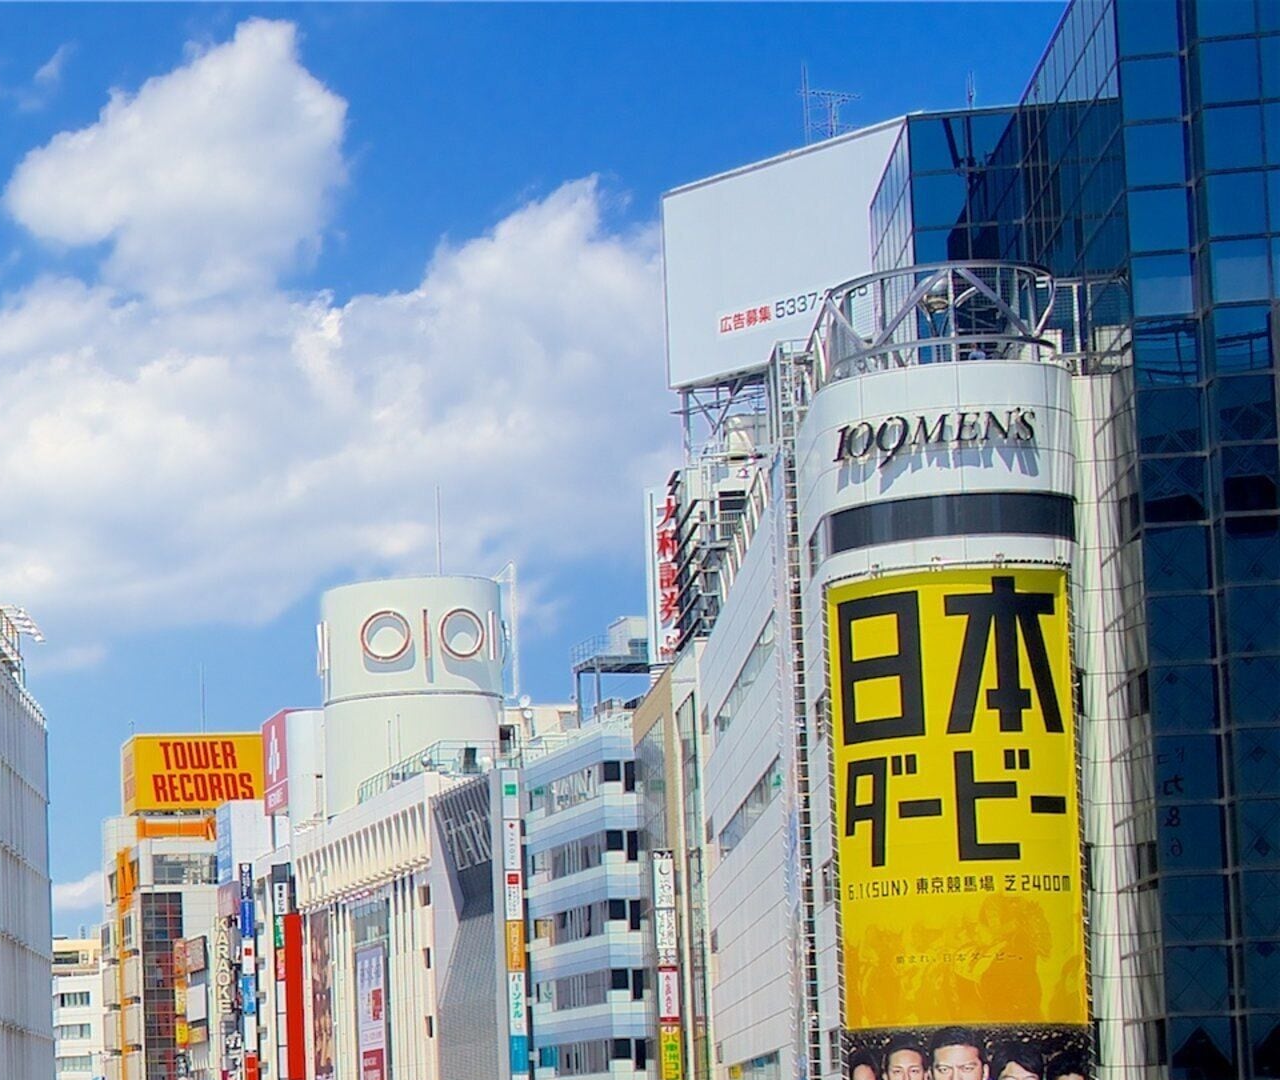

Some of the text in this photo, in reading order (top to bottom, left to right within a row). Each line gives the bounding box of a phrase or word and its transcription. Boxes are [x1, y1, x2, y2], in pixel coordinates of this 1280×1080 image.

[720, 306, 771, 333] 広告募集
[837, 577, 1064, 745] 日本
[159, 741, 237, 769] TOWER
[153, 773, 255, 802] RECORDS
[845, 749, 1066, 867] ダービー
[916, 875, 995, 894] 東京競馬場
[216, 916, 233, 1014] KARAOKE
